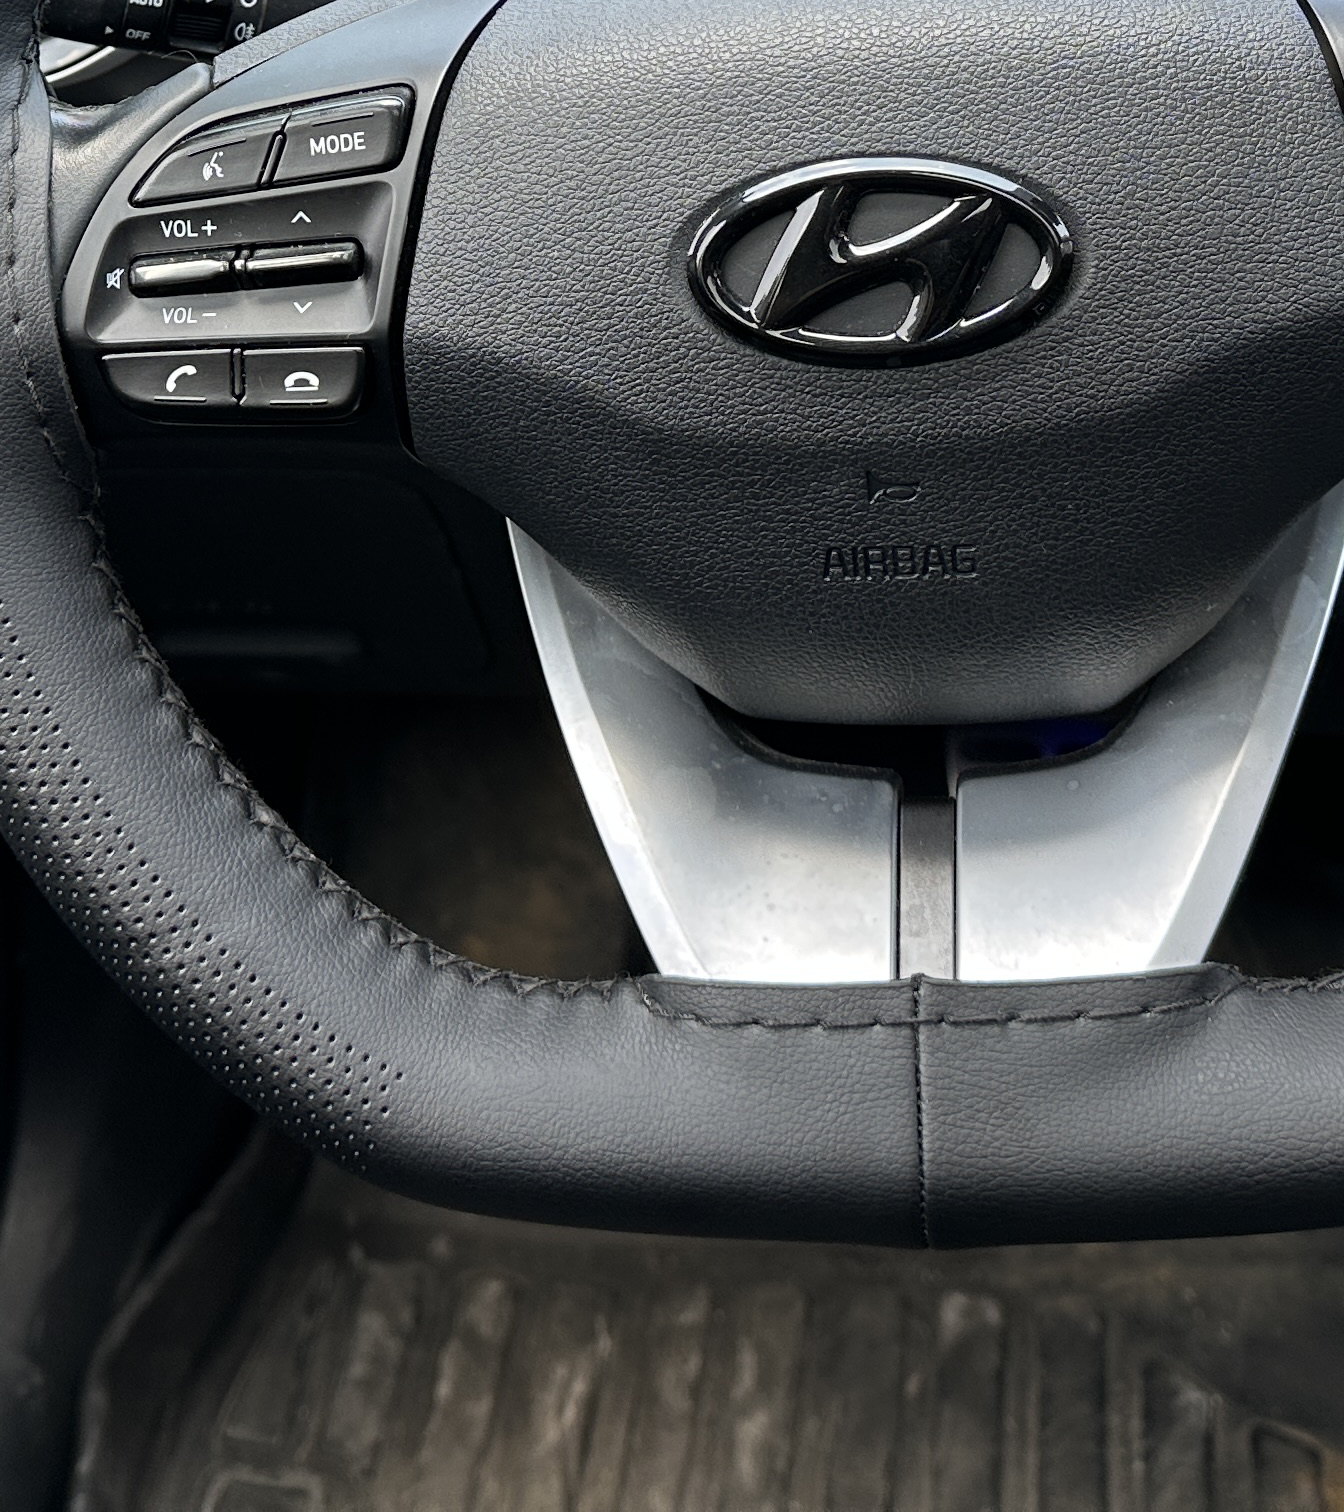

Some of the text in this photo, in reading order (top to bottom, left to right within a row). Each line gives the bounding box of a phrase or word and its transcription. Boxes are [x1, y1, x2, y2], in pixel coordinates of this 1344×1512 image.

[125, 27, 152, 41] OFF
[310, 132, 366, 156] MODE
[822, 544, 981, 582] AIRBAG
